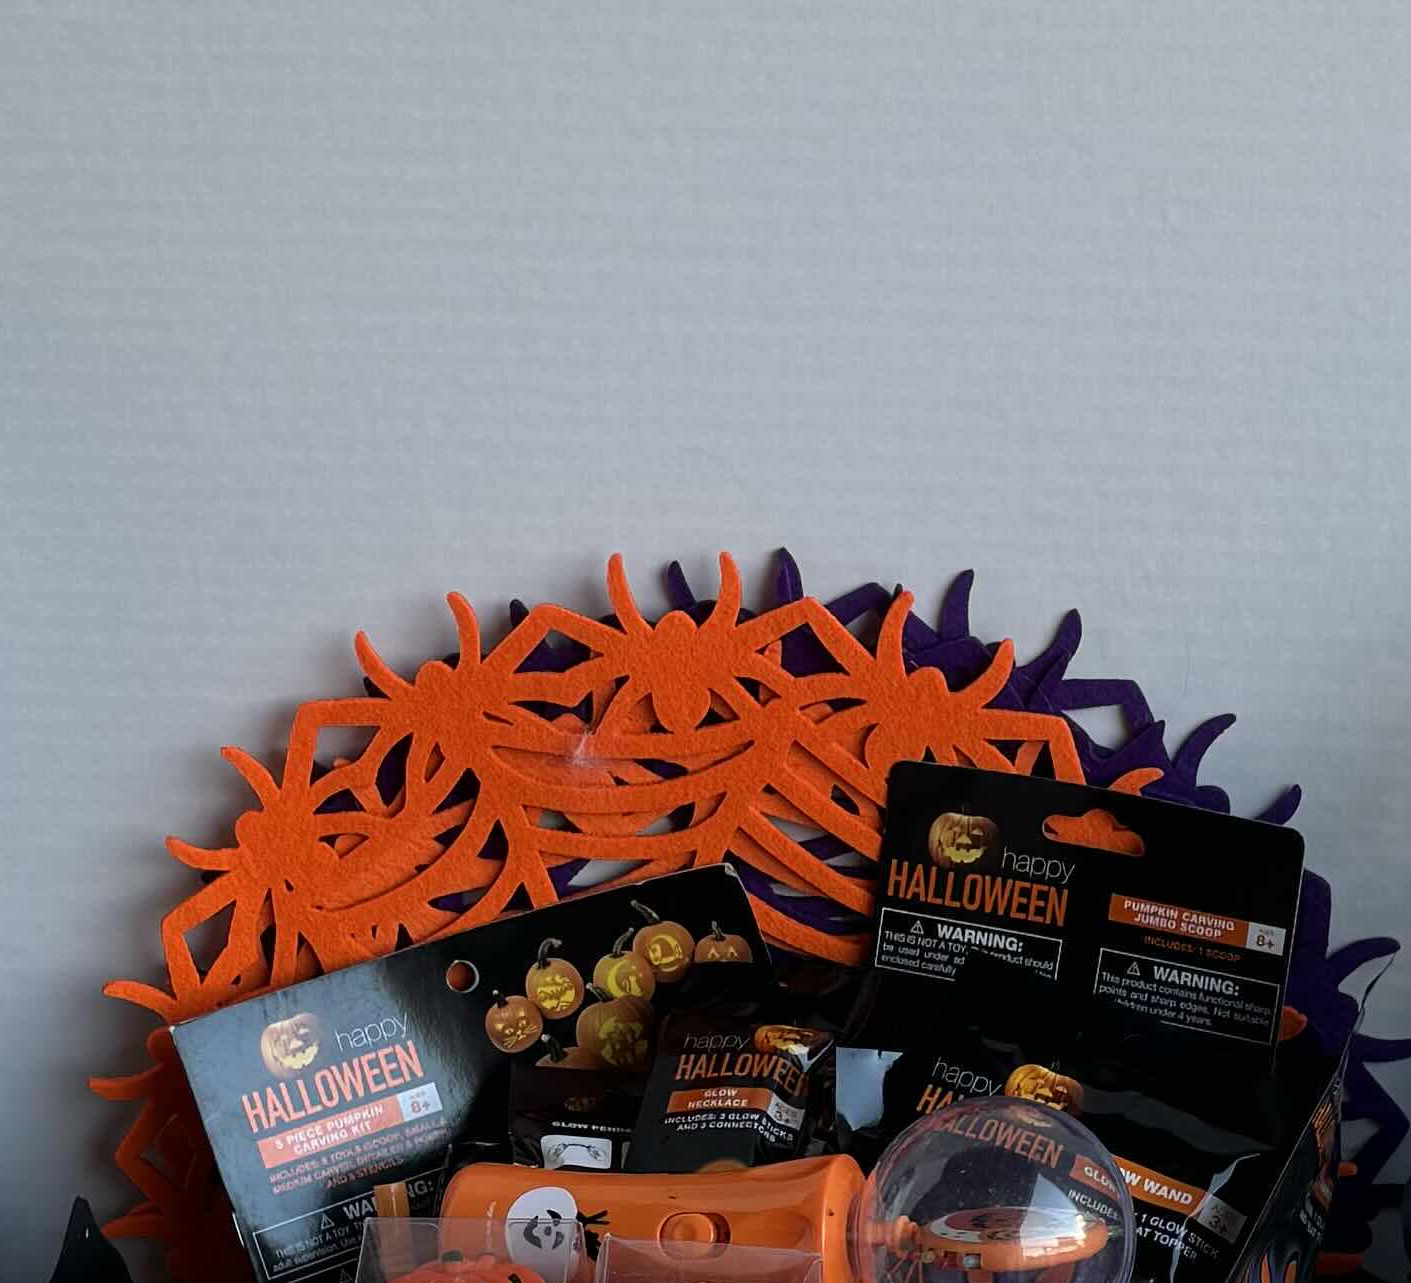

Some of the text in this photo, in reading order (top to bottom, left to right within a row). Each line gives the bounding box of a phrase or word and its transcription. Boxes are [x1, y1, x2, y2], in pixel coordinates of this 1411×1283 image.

[1002, 846, 1076, 885] happy
[888, 858, 1070, 927] HALLOWEEN
[1124, 899, 1235, 931] PUMPKIN CARVING
[1134, 913, 1222, 938] JUMBO SCOOP
[937, 923, 1024, 953] WARNING:
[1255, 934, 1275, 949] 8+
[1098, 985, 1127, 999] points
[1101, 971, 1197, 1000] This product contains
[1153, 965, 1240, 996] WARNING:
[334, 1011, 409, 1053] happy
[683, 1032, 750, 1051] happy
[241, 1040, 424, 1133] HALLOWEEN
[932, 1057, 1002, 1097] happy
[688, 1098, 749, 1109] NECKLACE
[703, 1088, 738, 1098] GLOW
[327, 1105, 384, 1133] PUMPKIN
[293, 1119, 372, 1153] CARVING KIT
[1143, 1180, 1194, 1206] WAND
[1150, 1216, 1185, 1237] GLOW
[1152, 1231, 1198, 1260] TOPPER
